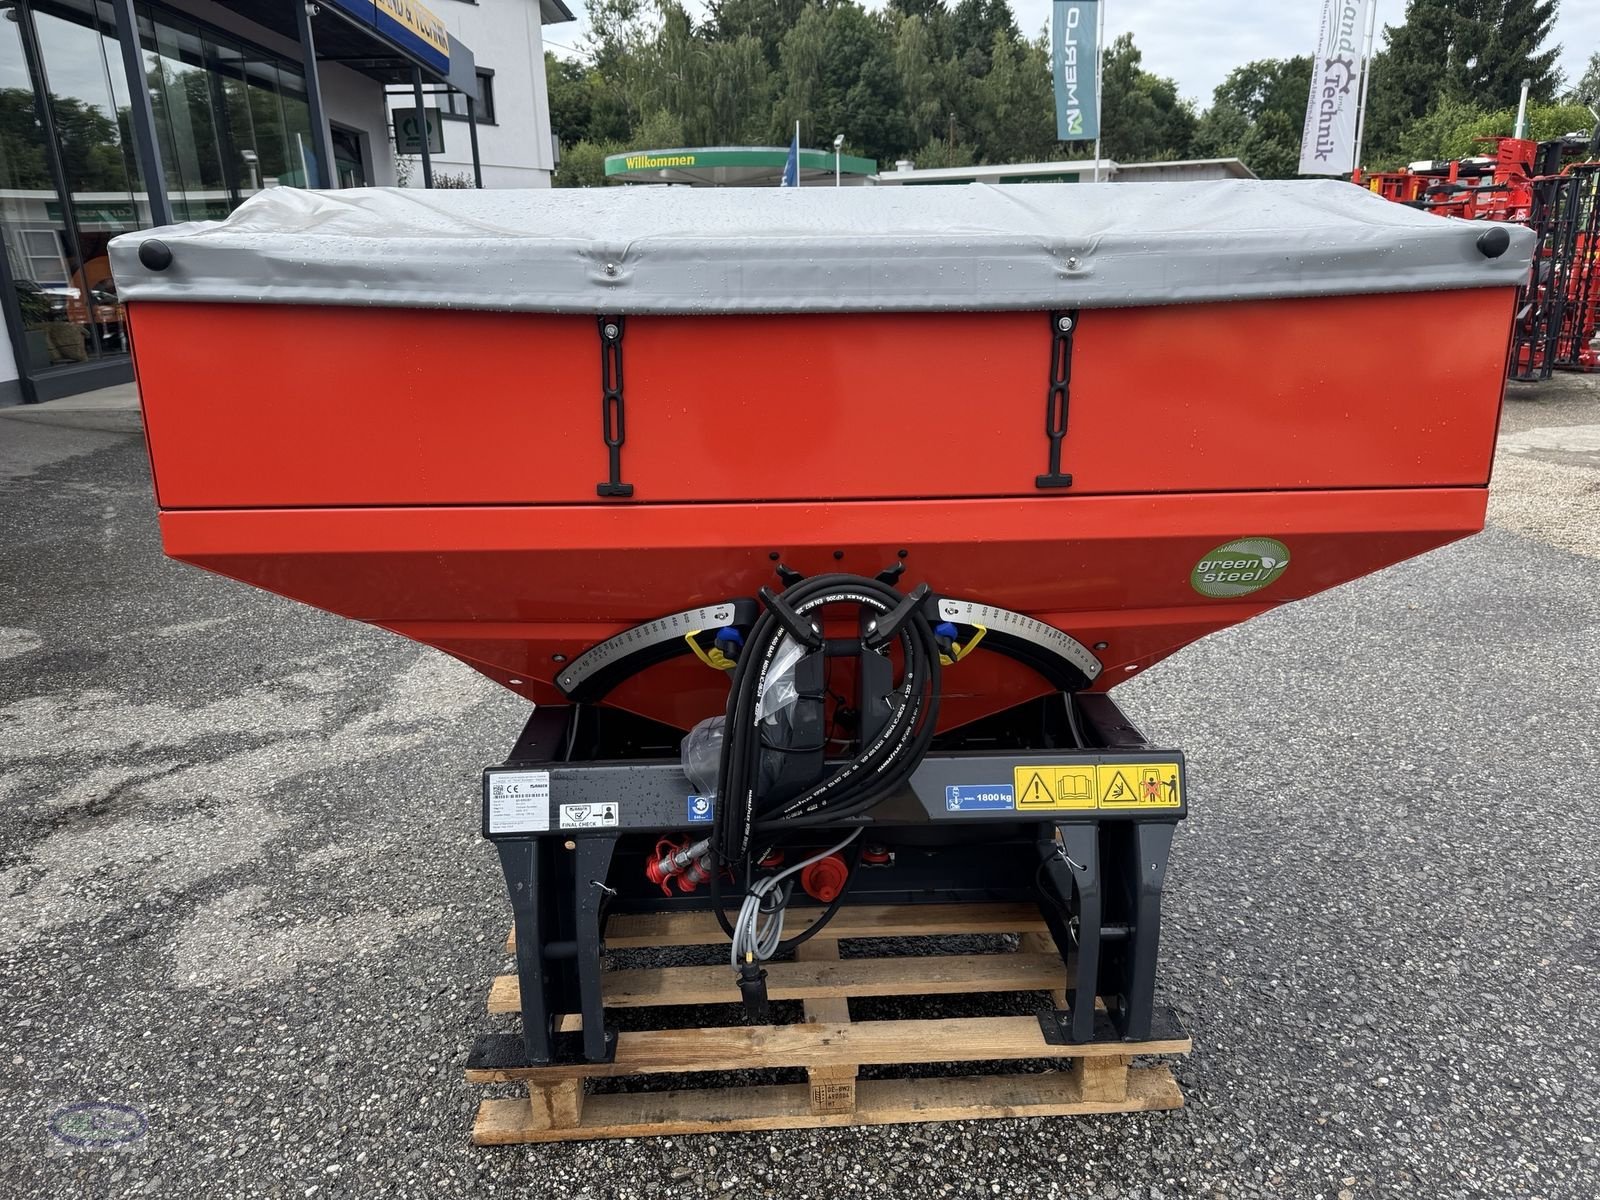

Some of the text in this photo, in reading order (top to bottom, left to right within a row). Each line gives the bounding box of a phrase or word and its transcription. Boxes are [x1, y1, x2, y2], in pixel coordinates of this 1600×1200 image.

[1338, 0, 1360, 54] Land
[1315, 74, 1341, 162] Technik
[626, 155, 695, 169] Willkommen
[1197, 559, 1260, 573] green
[1202, 569, 1263, 582] steel
[976, 793, 999, 802] 1800
[1000, 793, 1012, 803] kg
